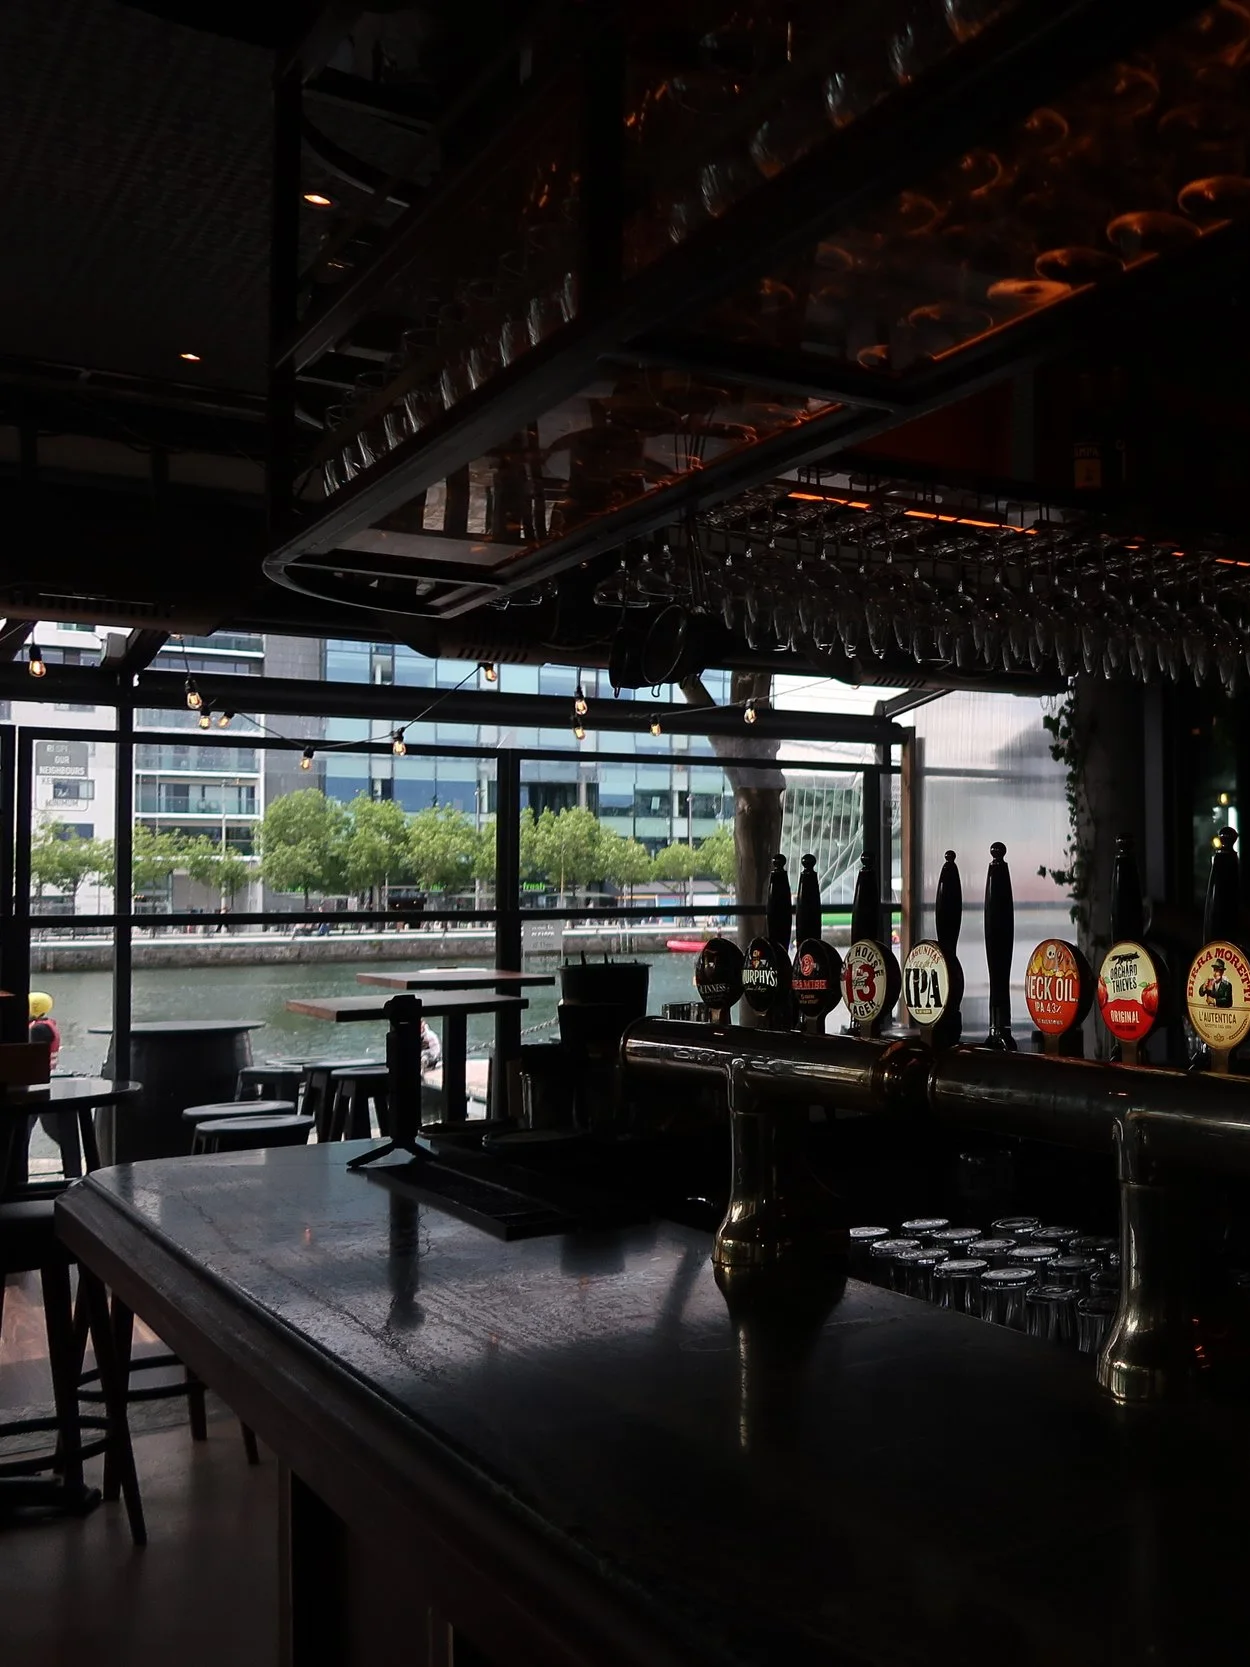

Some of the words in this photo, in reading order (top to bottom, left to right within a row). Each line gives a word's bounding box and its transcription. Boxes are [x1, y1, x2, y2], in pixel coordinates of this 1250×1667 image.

[523, 881, 546, 892] fresh
[855, 946, 883, 978] HOUSE
[1110, 964, 1138, 981] ORCHARD
[1188, 950, 1213, 997] BIRRA
[905, 968, 943, 1008] IPA
[1112, 976, 1138, 994] THIEVES
[852, 1000, 876, 1016] AGER
[1034, 1001, 1045, 1013] IPA
[1110, 1010, 1140, 1024] ORIGINAL
[1198, 1011, 1237, 1024] L'AUTENTICA
